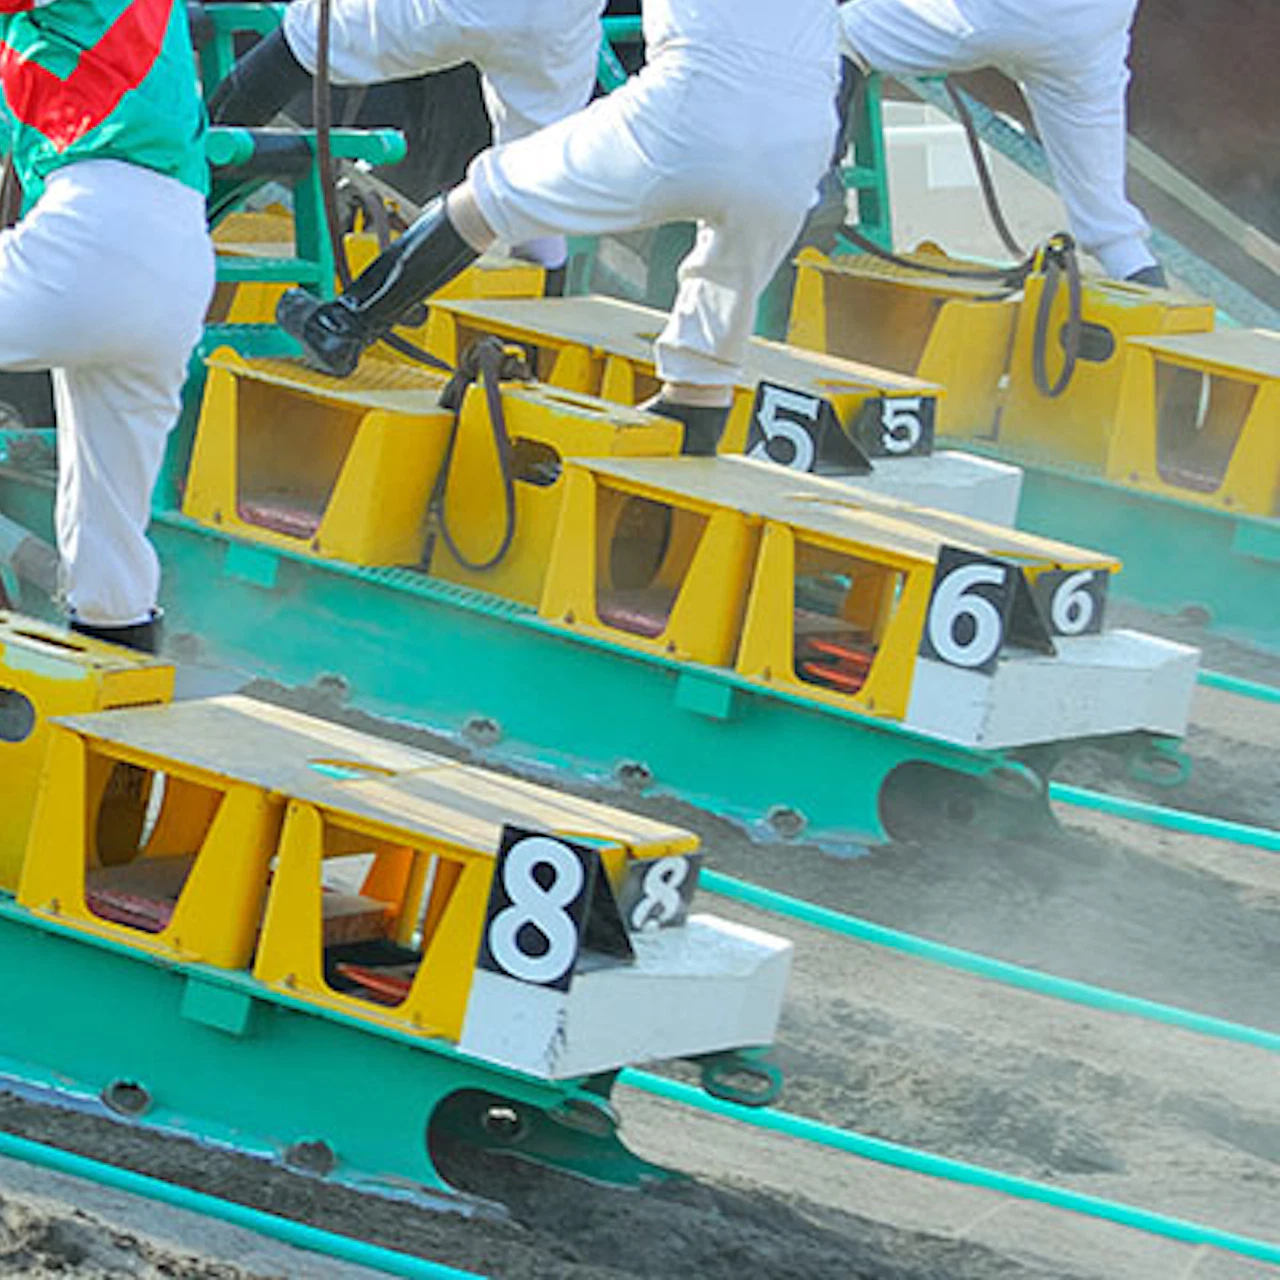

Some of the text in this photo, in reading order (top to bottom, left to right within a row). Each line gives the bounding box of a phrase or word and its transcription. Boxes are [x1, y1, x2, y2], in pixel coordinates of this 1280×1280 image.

[746, 385, 820, 473] 5
[881, 397, 924, 453] 5
[928, 562, 1006, 668] 6
[1051, 570, 1095, 635] 6
[488, 836, 585, 983] 8
[632, 856, 688, 930] 8
